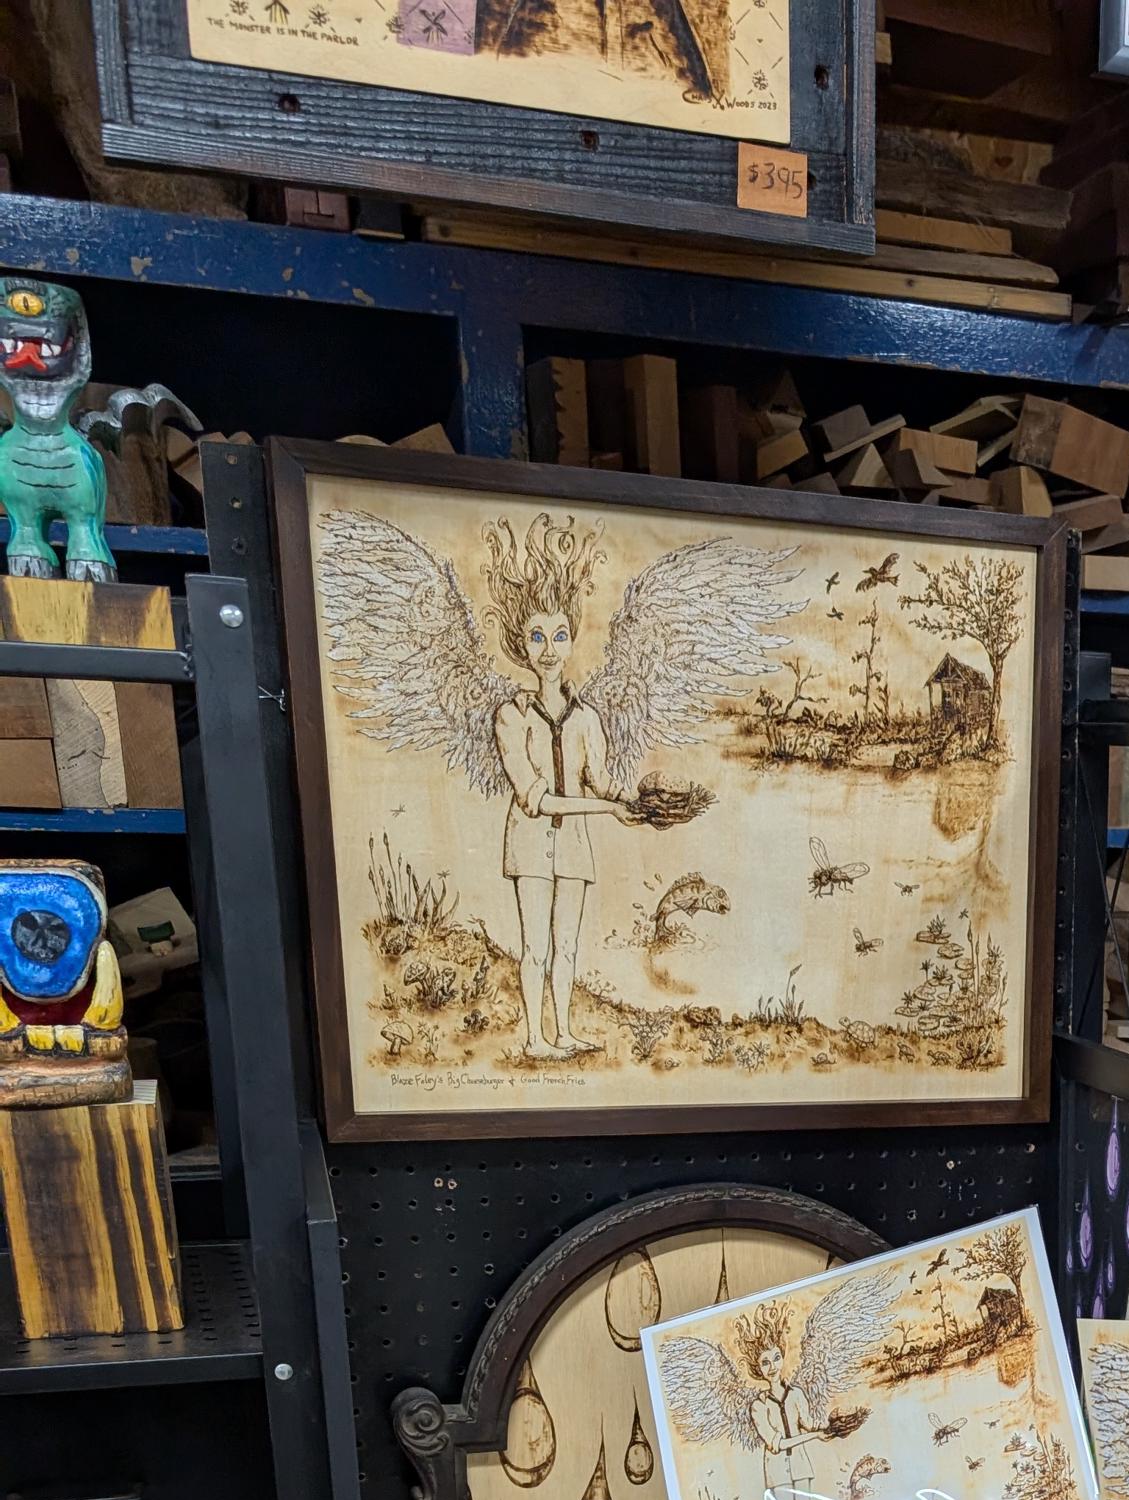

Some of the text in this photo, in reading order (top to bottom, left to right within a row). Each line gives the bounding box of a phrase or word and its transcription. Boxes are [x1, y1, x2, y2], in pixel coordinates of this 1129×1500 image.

[207, 17, 359, 46] THE MONSTER IS IN THE PARLOR
[758, 102, 777, 110] 2023
[747, 161, 803, 199] $395
[447, 1072, 460, 1088] Big
